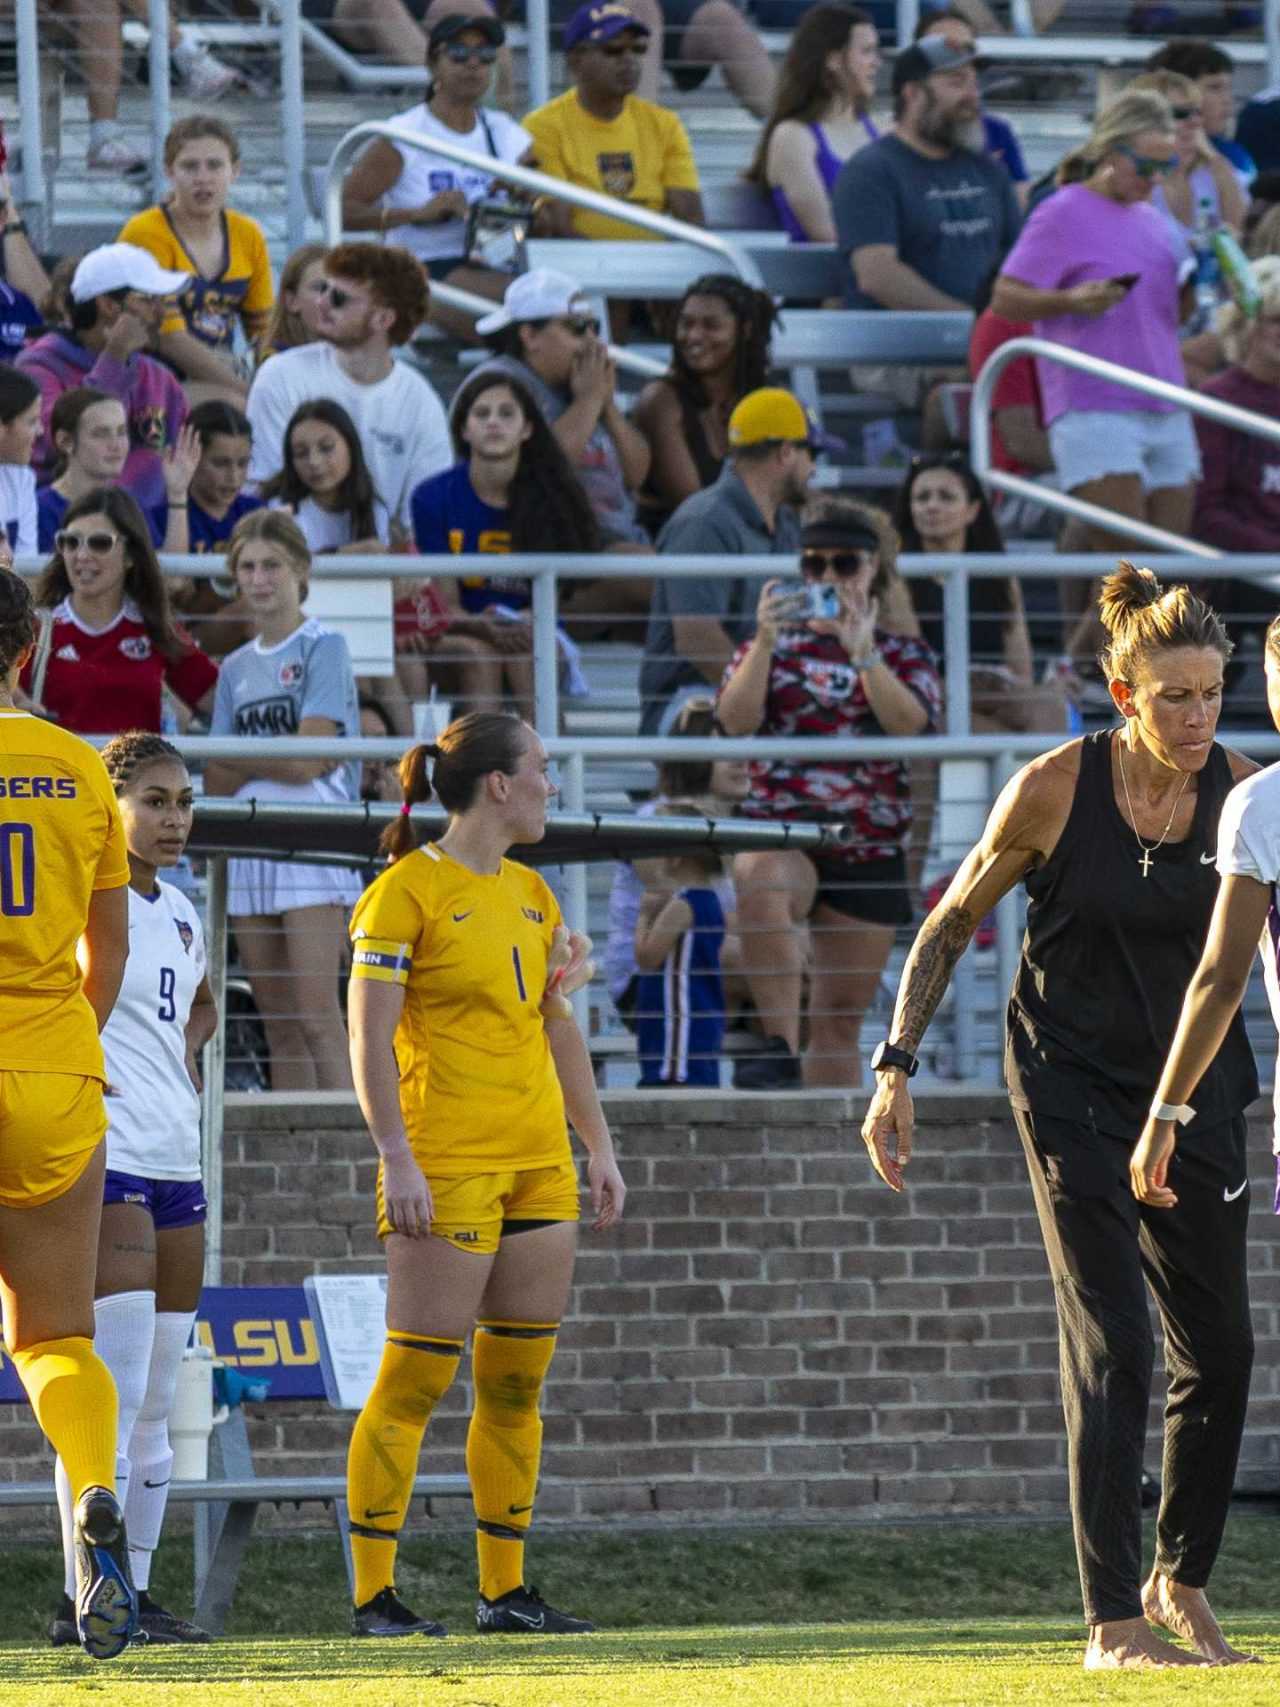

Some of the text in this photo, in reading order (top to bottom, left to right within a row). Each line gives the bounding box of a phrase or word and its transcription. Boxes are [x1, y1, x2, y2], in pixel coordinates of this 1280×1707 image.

[158, 967, 176, 1022] 9
[512, 946, 527, 1001] 1
[195, 1319, 321, 1367] LSU
